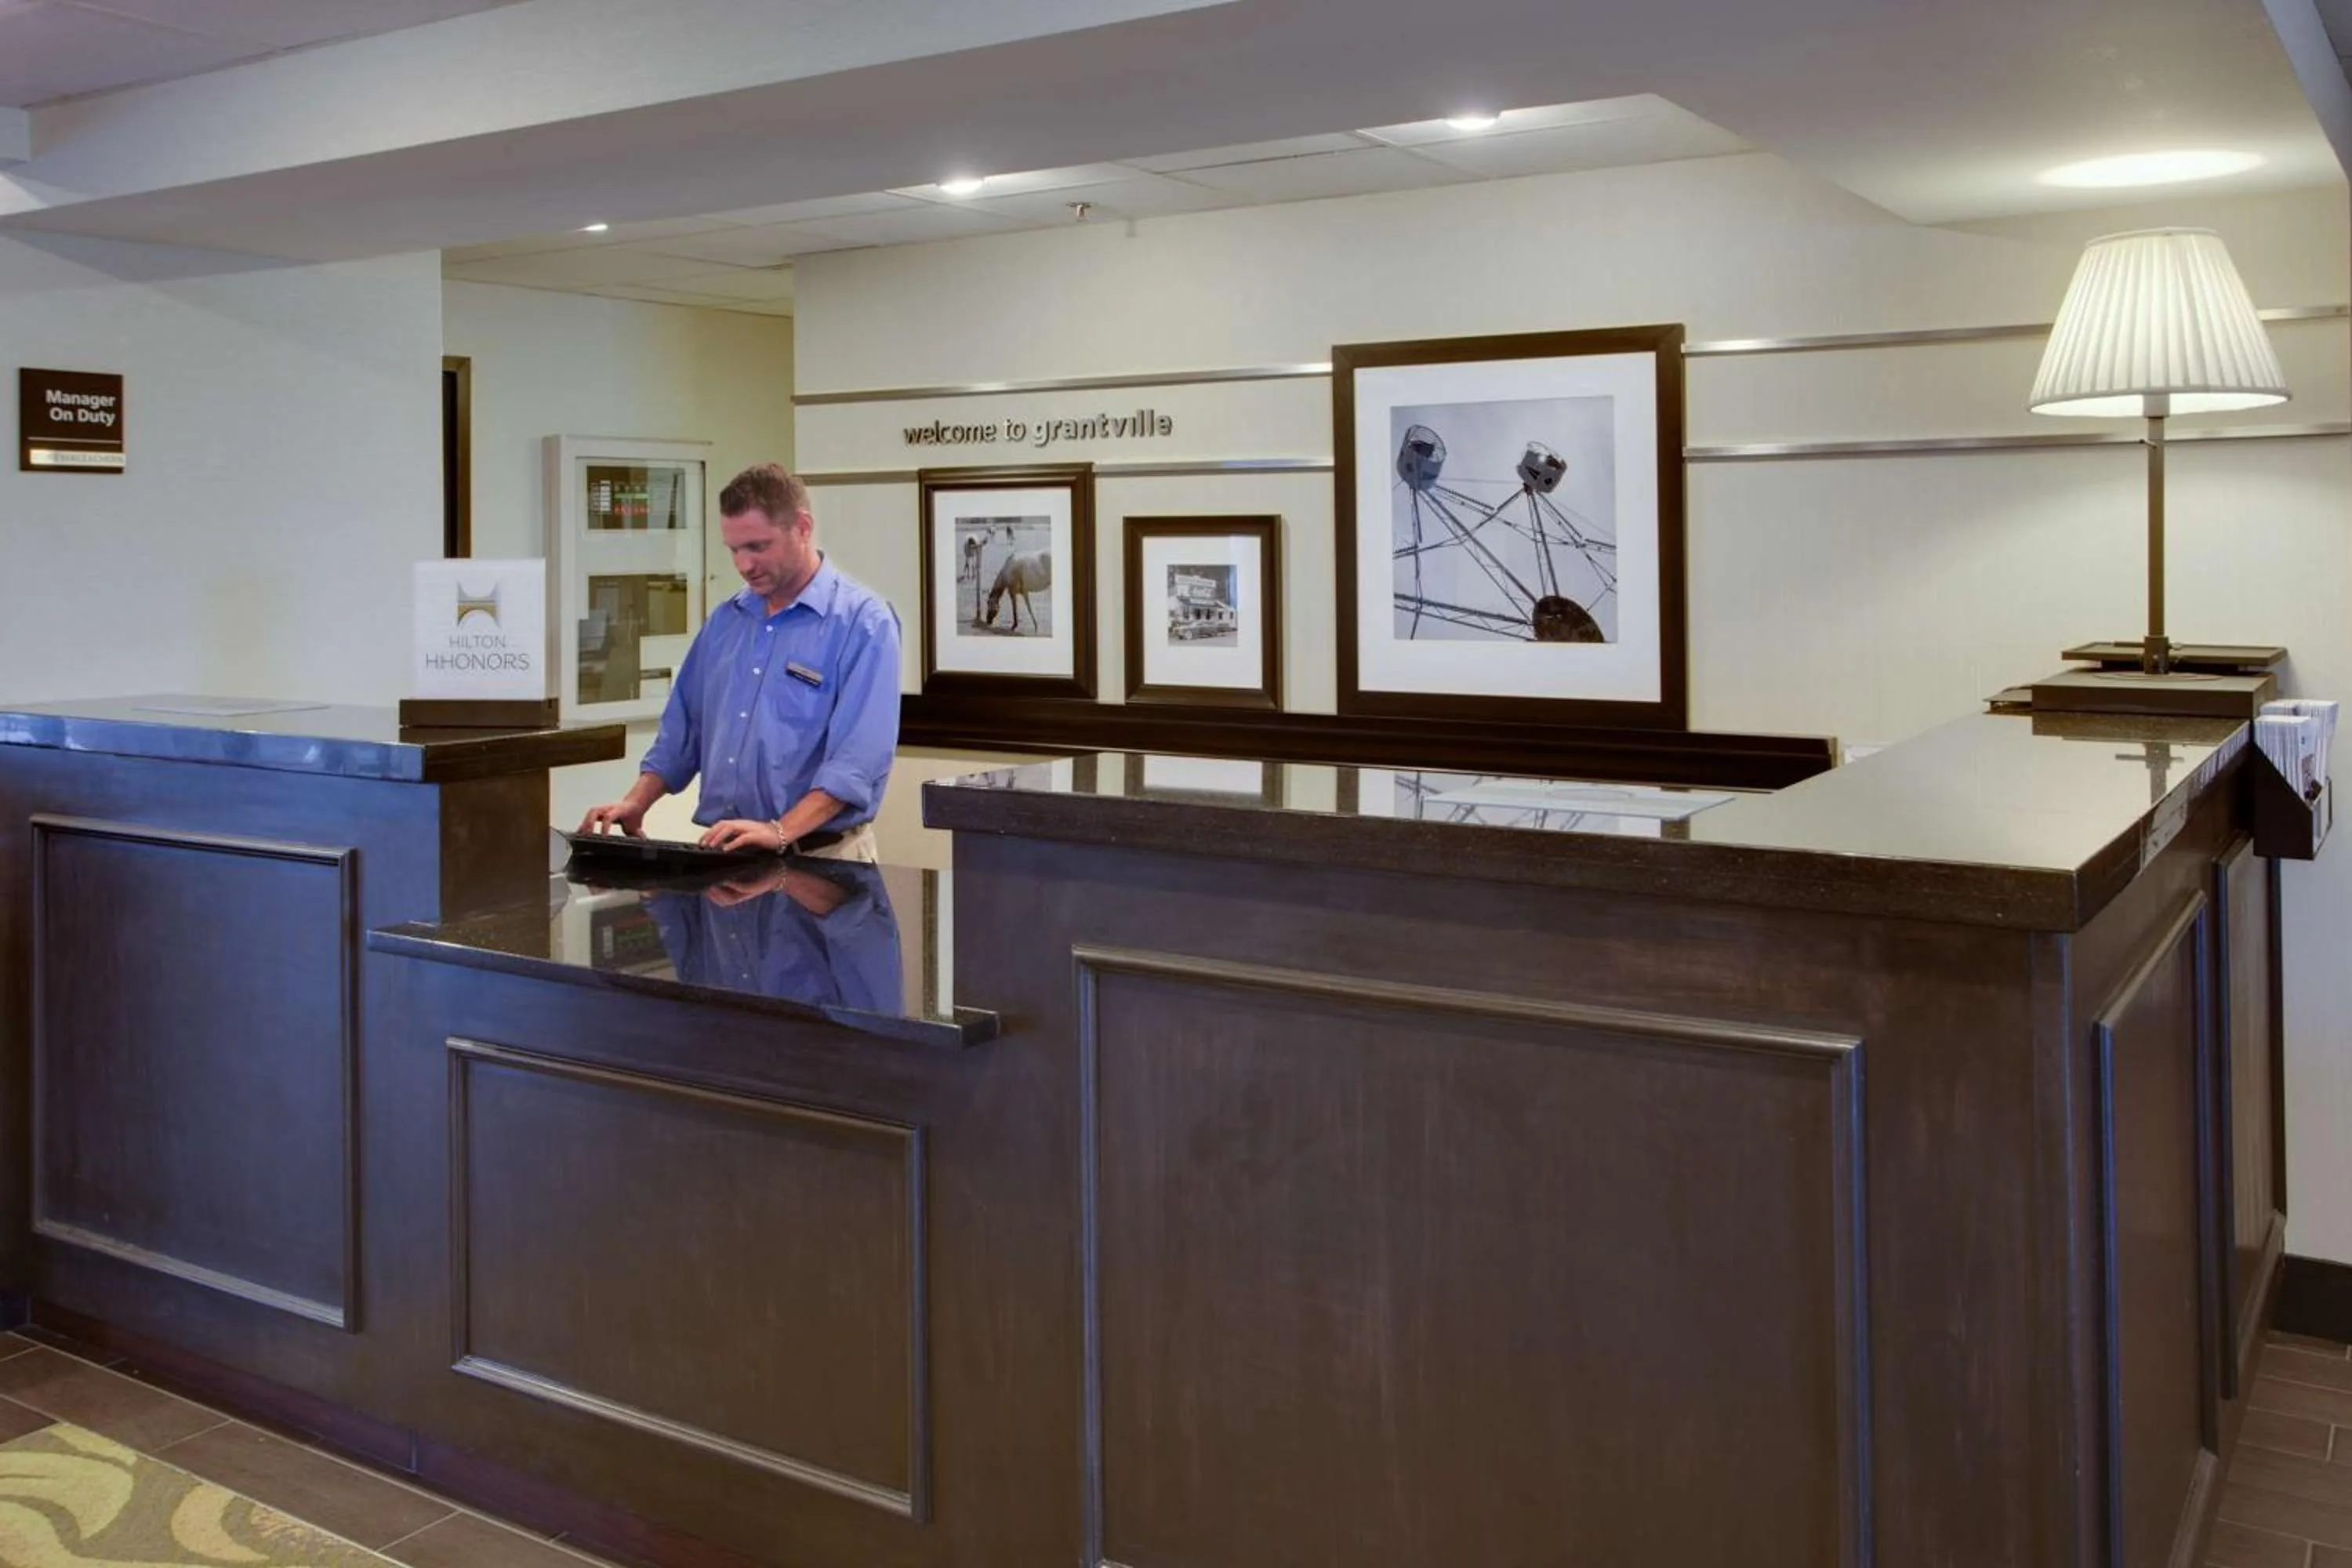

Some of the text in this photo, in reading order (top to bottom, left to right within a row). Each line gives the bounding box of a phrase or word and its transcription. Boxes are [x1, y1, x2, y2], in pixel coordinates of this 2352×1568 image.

[45, 389, 116, 409] Manager
[50, 407, 115, 426] On Duty
[904, 409, 1173, 448] welcome to grantville
[449, 634, 506, 649] HILTON
[426, 652, 530, 670] HHONORS
